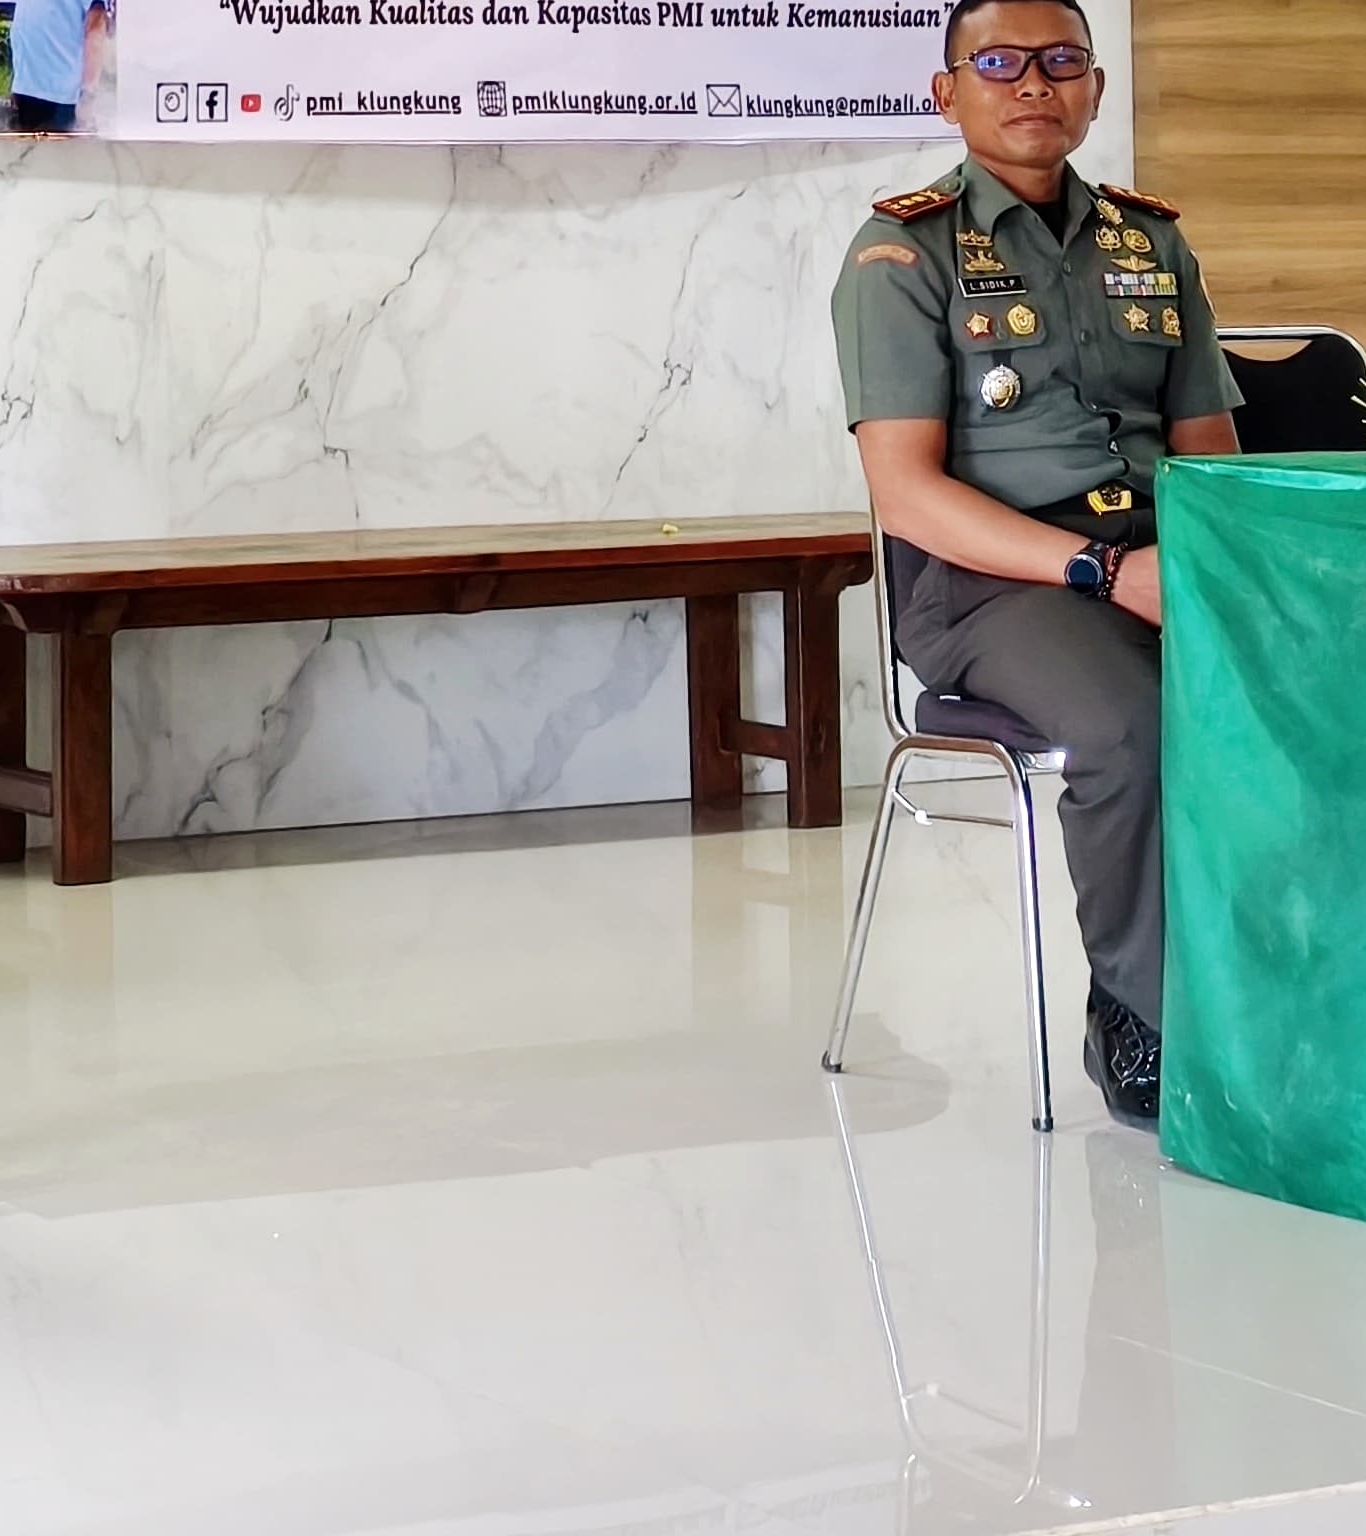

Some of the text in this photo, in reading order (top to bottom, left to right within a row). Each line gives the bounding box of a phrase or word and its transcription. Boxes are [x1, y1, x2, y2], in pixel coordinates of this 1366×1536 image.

[657, 2, 704, 27] PMI
[711, 1, 779, 27] untuk
[784, 0, 953, 30] Kemanusiaan”
